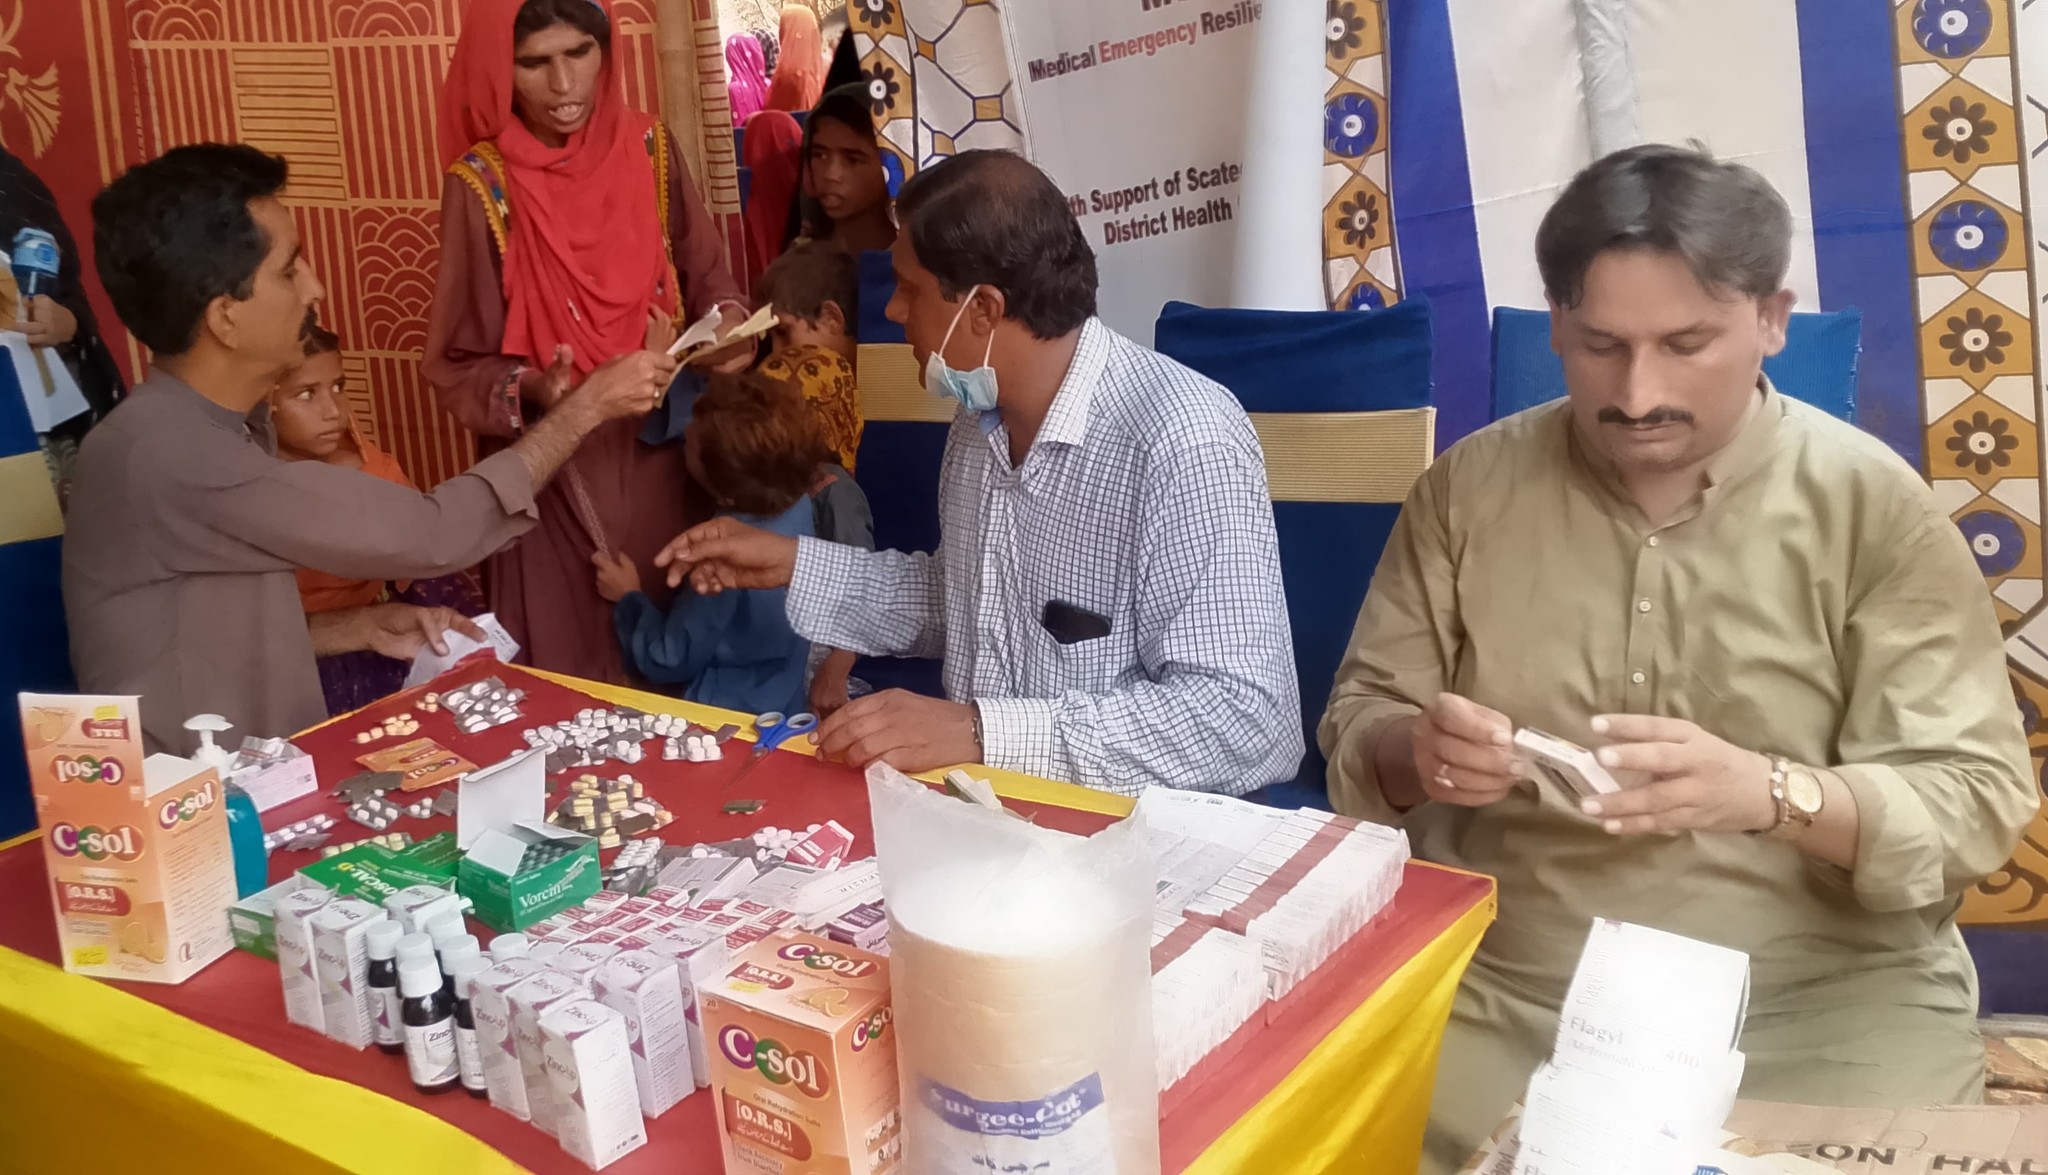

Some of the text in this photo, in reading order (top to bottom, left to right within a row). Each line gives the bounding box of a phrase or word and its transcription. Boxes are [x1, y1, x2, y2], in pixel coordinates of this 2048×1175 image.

[1028, 45, 1097, 82] Medical
[1099, 21, 1197, 63] Emergency
[1090, 177, 1160, 215] Support
[1164, 170, 1182, 197] of
[1186, 161, 1243, 191] Scate
[1104, 197, 1233, 245] District Health
[55, 760, 122, 783] C-sol
[160, 782, 215, 824] C-sol
[52, 824, 137, 854] C-sol
[519, 883, 561, 907] Vorcin
[784, 943, 872, 977] C-sol
[1570, 1016, 1623, 1045] Flagyl
[725, 1026, 820, 1092] C-sol
